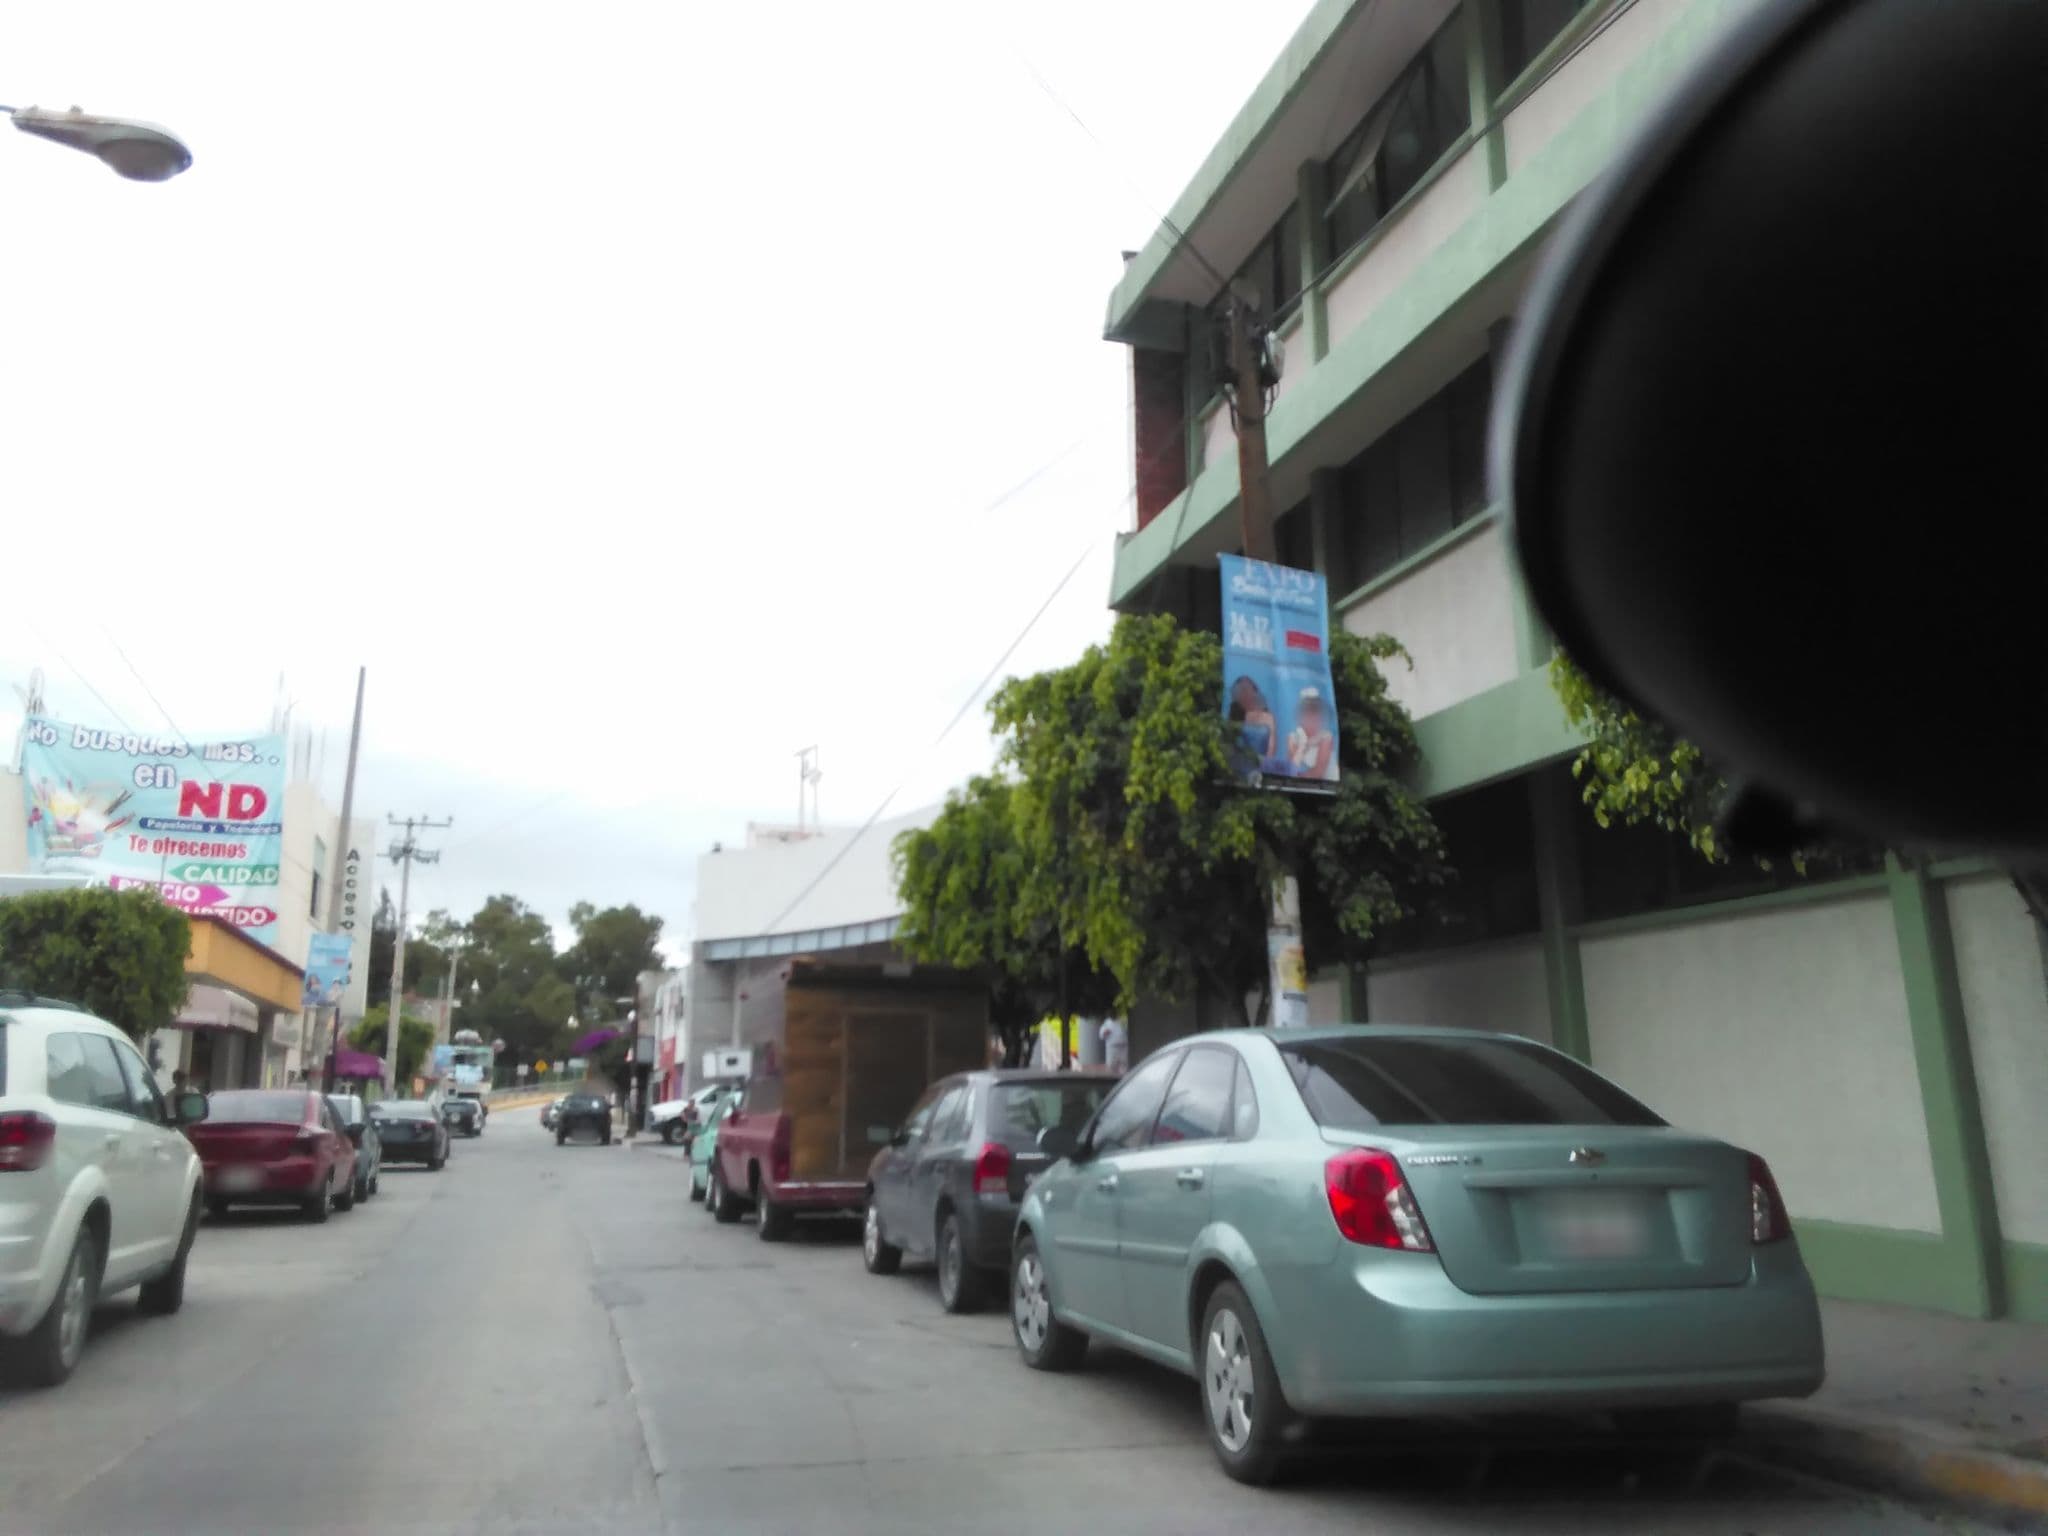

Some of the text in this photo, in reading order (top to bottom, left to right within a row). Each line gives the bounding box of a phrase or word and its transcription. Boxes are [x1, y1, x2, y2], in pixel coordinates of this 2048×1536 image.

[28, 719, 58, 746] No
[72, 725, 190, 758] busques
[133, 763, 176, 789] en
[178, 779, 268, 820] ND
[129, 834, 248, 859] Te ofrecemos
[183, 865, 279, 885] CALIDAD
